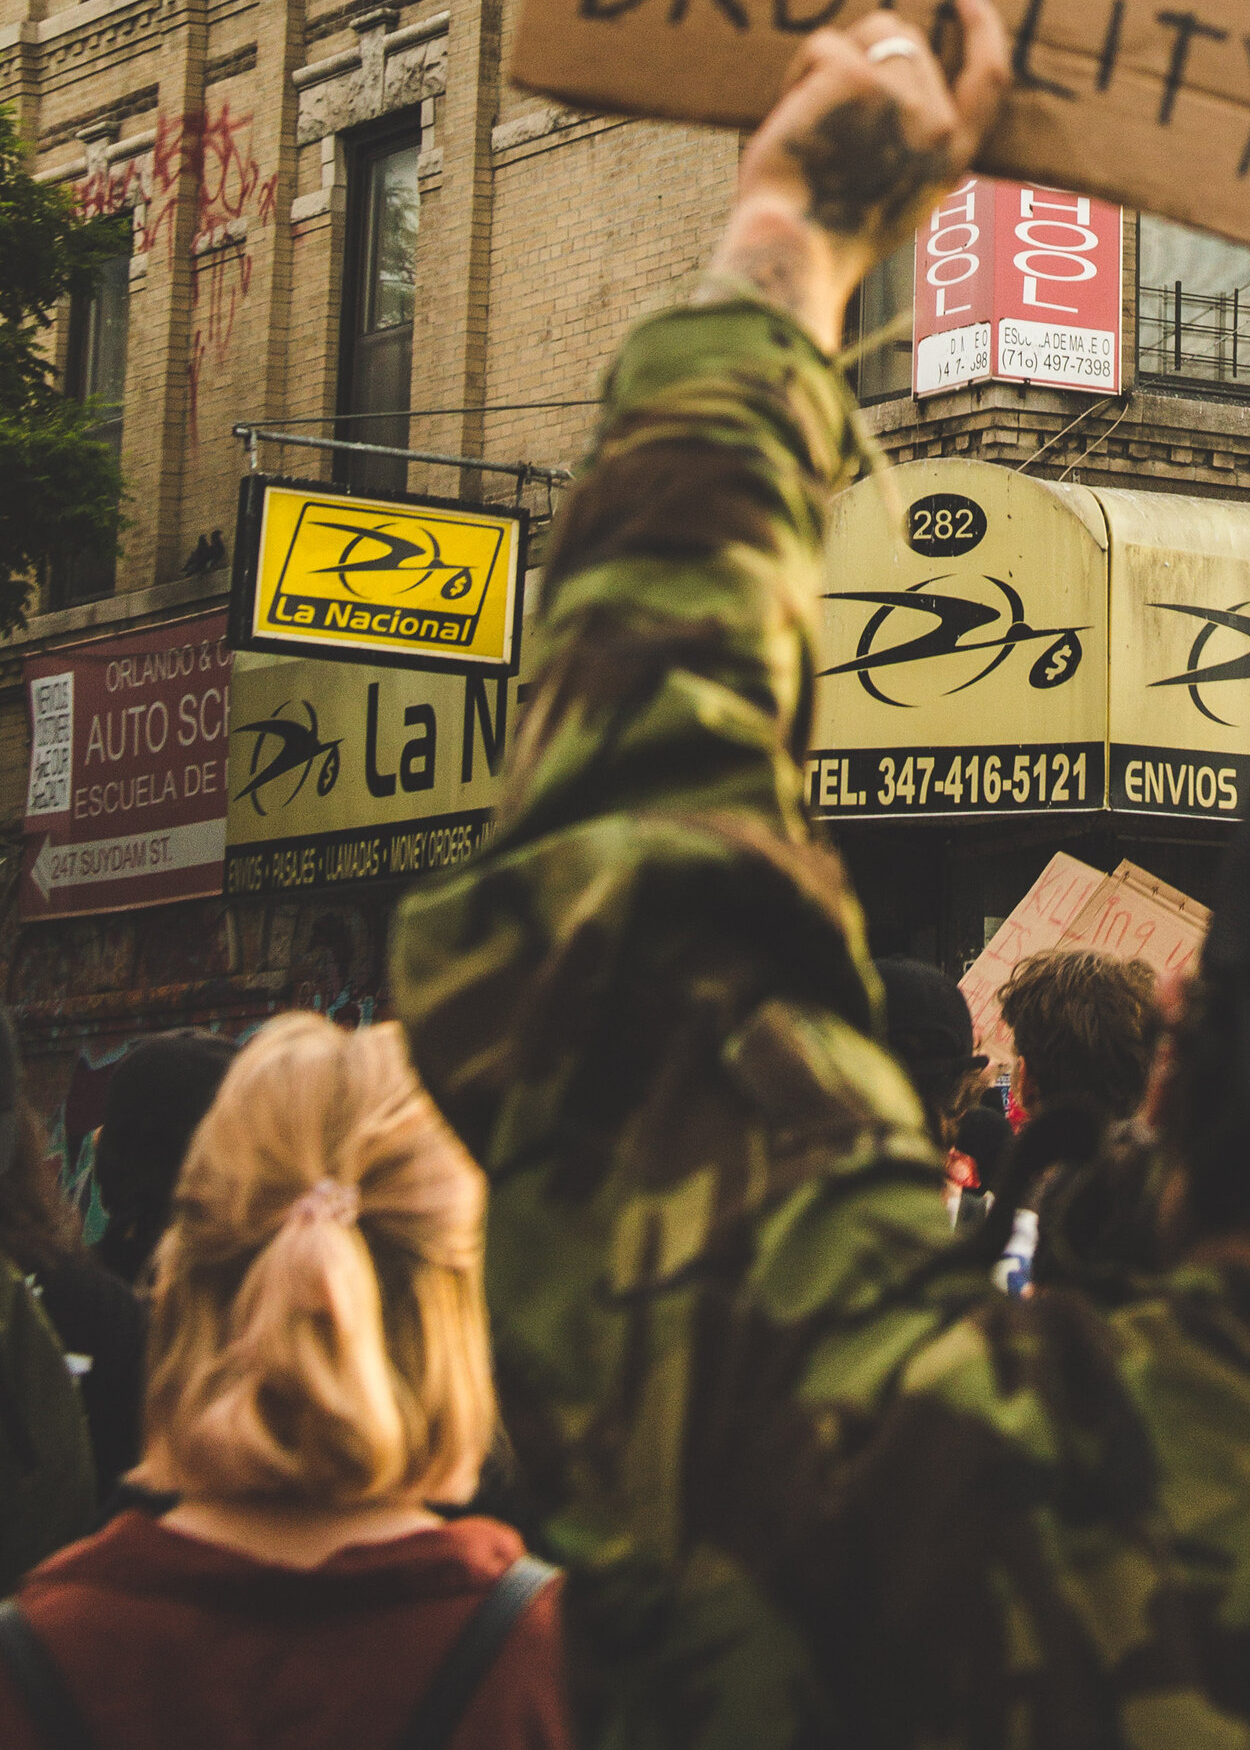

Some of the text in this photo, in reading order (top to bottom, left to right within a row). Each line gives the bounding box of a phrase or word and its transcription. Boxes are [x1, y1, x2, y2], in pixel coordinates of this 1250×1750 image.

[926, 180, 980, 317] HOOL
[1013, 181, 1099, 314] HOOL
[1043, 353, 1111, 378] 497-7398
[1053, 332, 1067, 350] DE
[1069, 335, 1110, 356] MAEO
[912, 508, 974, 540] 282
[275, 596, 472, 642] La Nacional
[106, 644, 195, 693] ORLANDO
[200, 639, 212, 672] &
[84, 701, 169, 766] AUTO
[365, 682, 437, 798] La
[75, 770, 177, 820] ESCUELA
[184, 760, 217, 798] DE
[803, 752, 1087, 806] TEL. 347-416-5121
[1124, 760, 1239, 810] ENVIOS
[50, 851, 77, 880] 247
[81, 840, 148, 876] SUYDAM
[389, 832, 427, 873] MONEY
[428, 825, 472, 867] ORDERS
